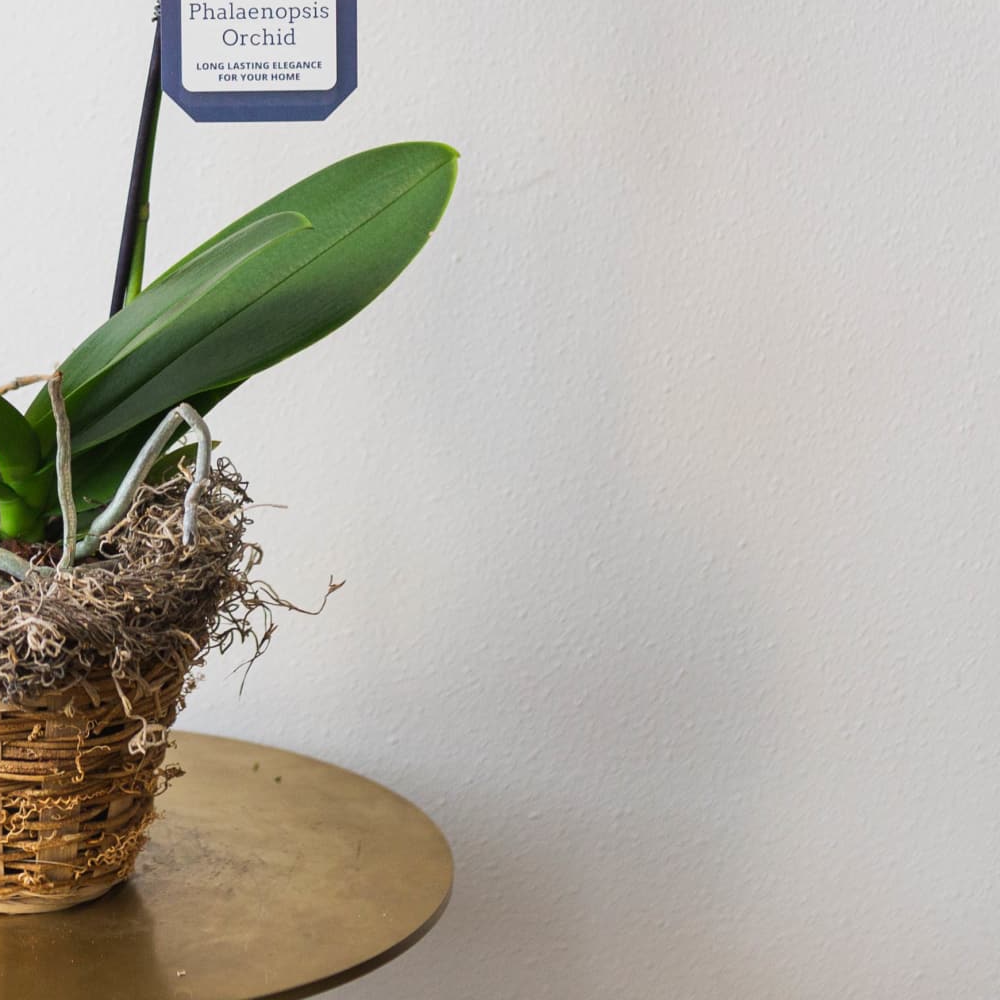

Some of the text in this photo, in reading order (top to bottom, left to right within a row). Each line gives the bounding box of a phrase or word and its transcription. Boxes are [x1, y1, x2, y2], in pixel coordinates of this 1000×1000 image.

[189, 1, 329, 24] Phalaenopsis
[222, 27, 297, 47] Orchid
[196, 60, 322, 71] LONG LASTING ELEGANCE
[218, 72, 301, 82] FOR YOUR HOME
